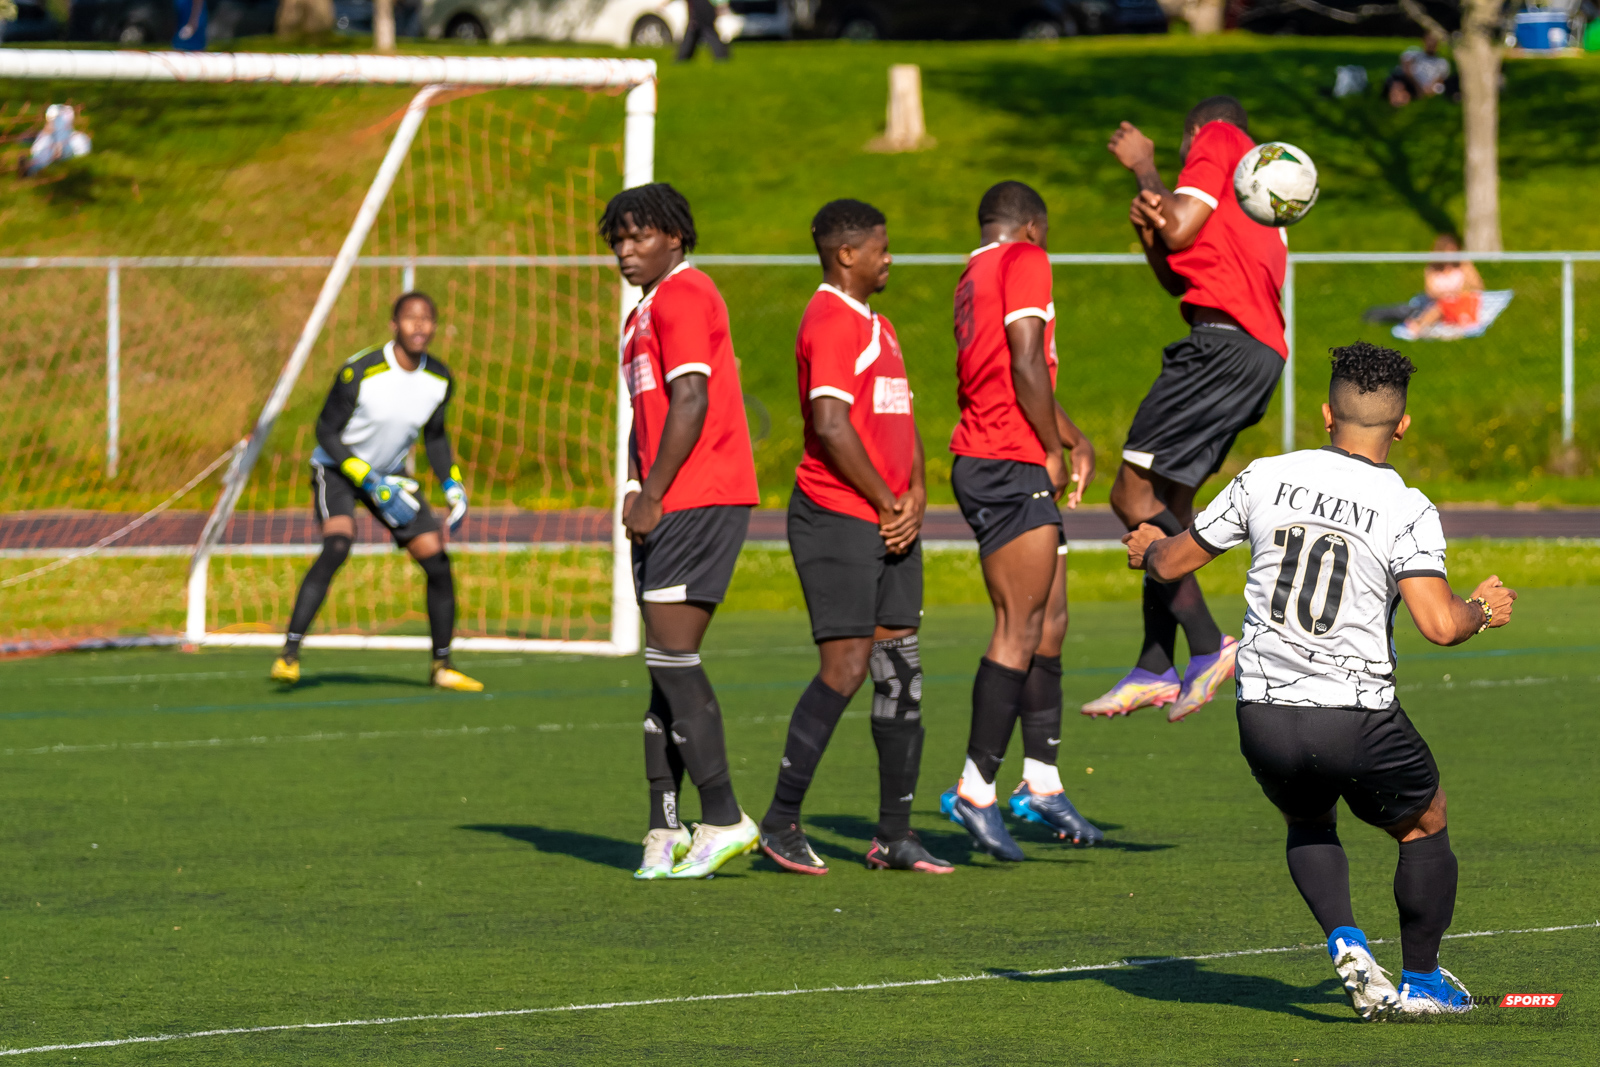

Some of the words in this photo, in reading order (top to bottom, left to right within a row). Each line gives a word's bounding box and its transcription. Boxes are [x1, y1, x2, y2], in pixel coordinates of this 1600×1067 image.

[1272, 482, 1310, 511] FC
[1309, 492, 1379, 534] KENT
[1270, 523, 1350, 636] 10
